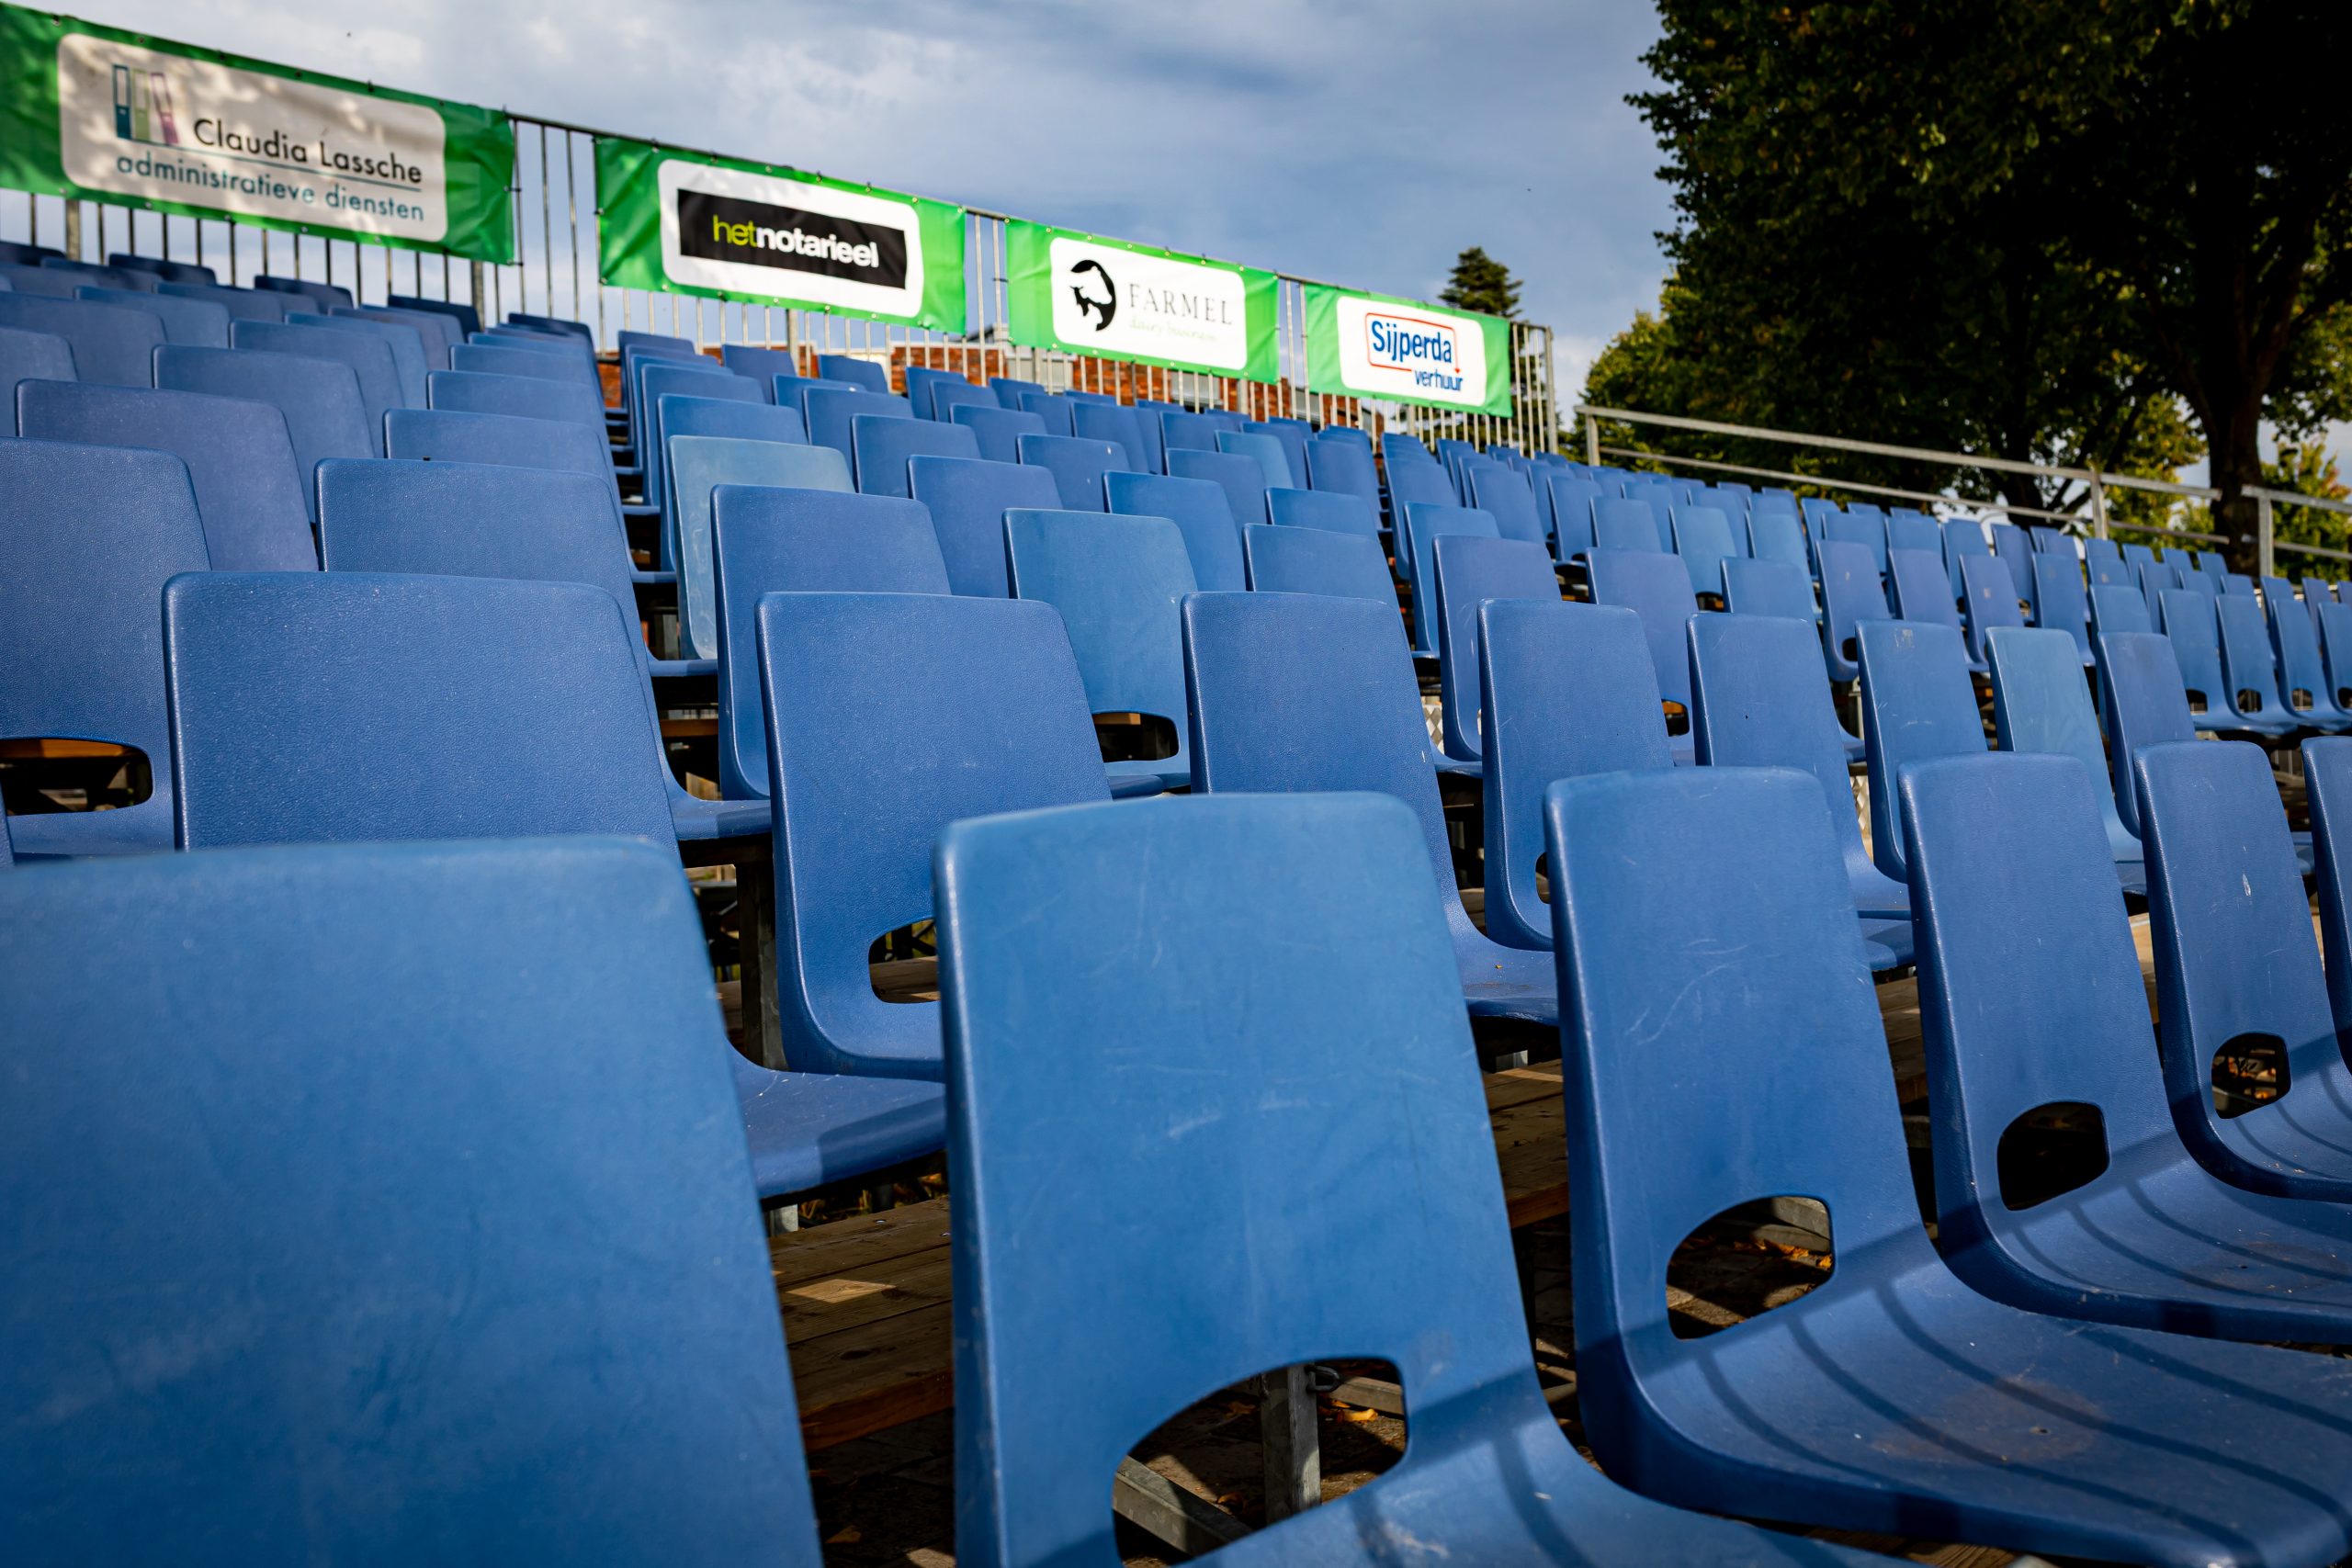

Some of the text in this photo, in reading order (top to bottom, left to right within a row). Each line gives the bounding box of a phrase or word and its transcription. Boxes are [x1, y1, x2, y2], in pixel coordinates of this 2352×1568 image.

[193, 118, 423, 185] Claudia Lassche
[116, 151, 424, 221] administratieve diensten
[712, 214, 879, 268] hetnotarieel
[1128, 283, 1232, 325] FARMEL
[1371, 321, 1453, 364] Sijperda
[1415, 368, 1464, 391] verhuur
